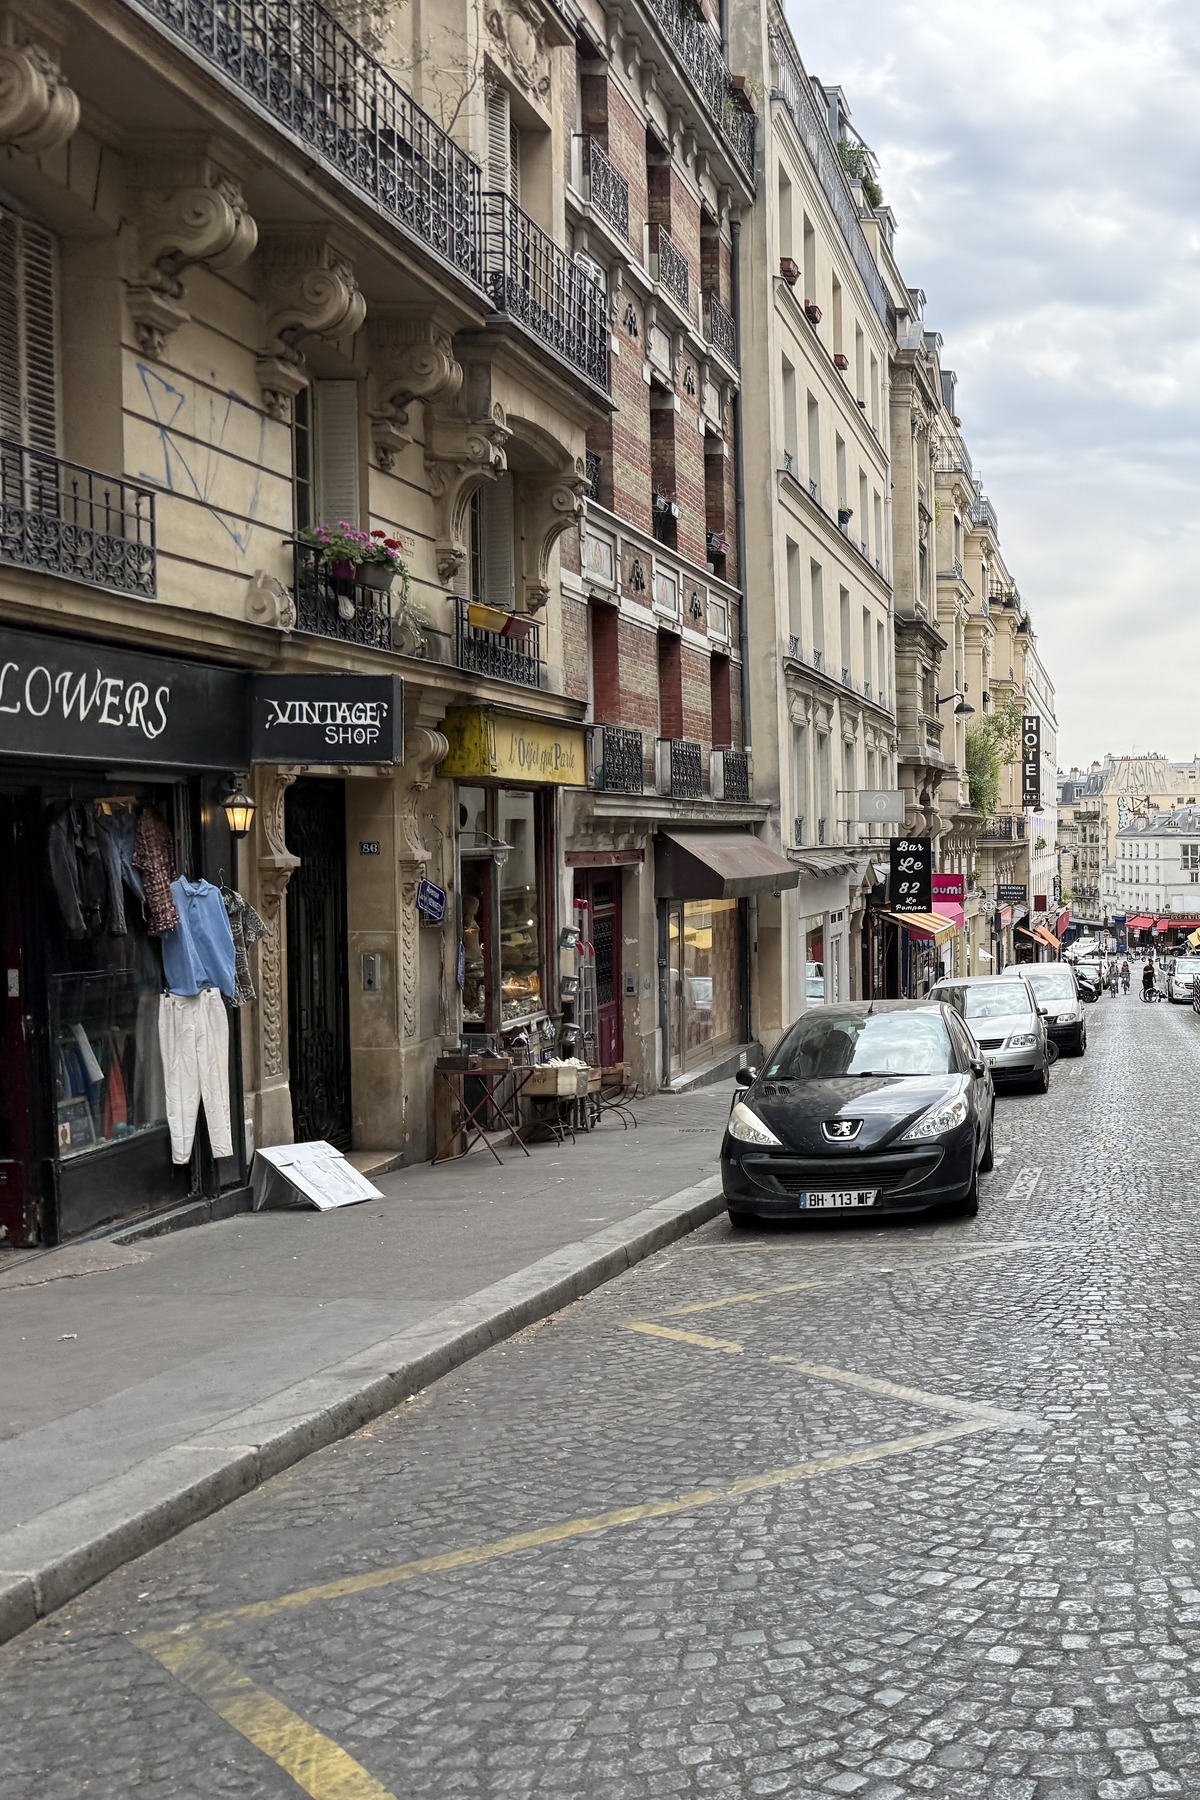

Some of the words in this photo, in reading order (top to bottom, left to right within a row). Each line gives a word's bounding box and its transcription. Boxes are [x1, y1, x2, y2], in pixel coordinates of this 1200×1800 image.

[267, 699, 387, 728] VINTAGE
[1024, 718, 1038, 791] HOTEL
[362, 843, 378, 854] 86
[896, 841, 925, 852] Bar
[898, 857, 924, 874] Le
[898, 882, 921, 894] 82
